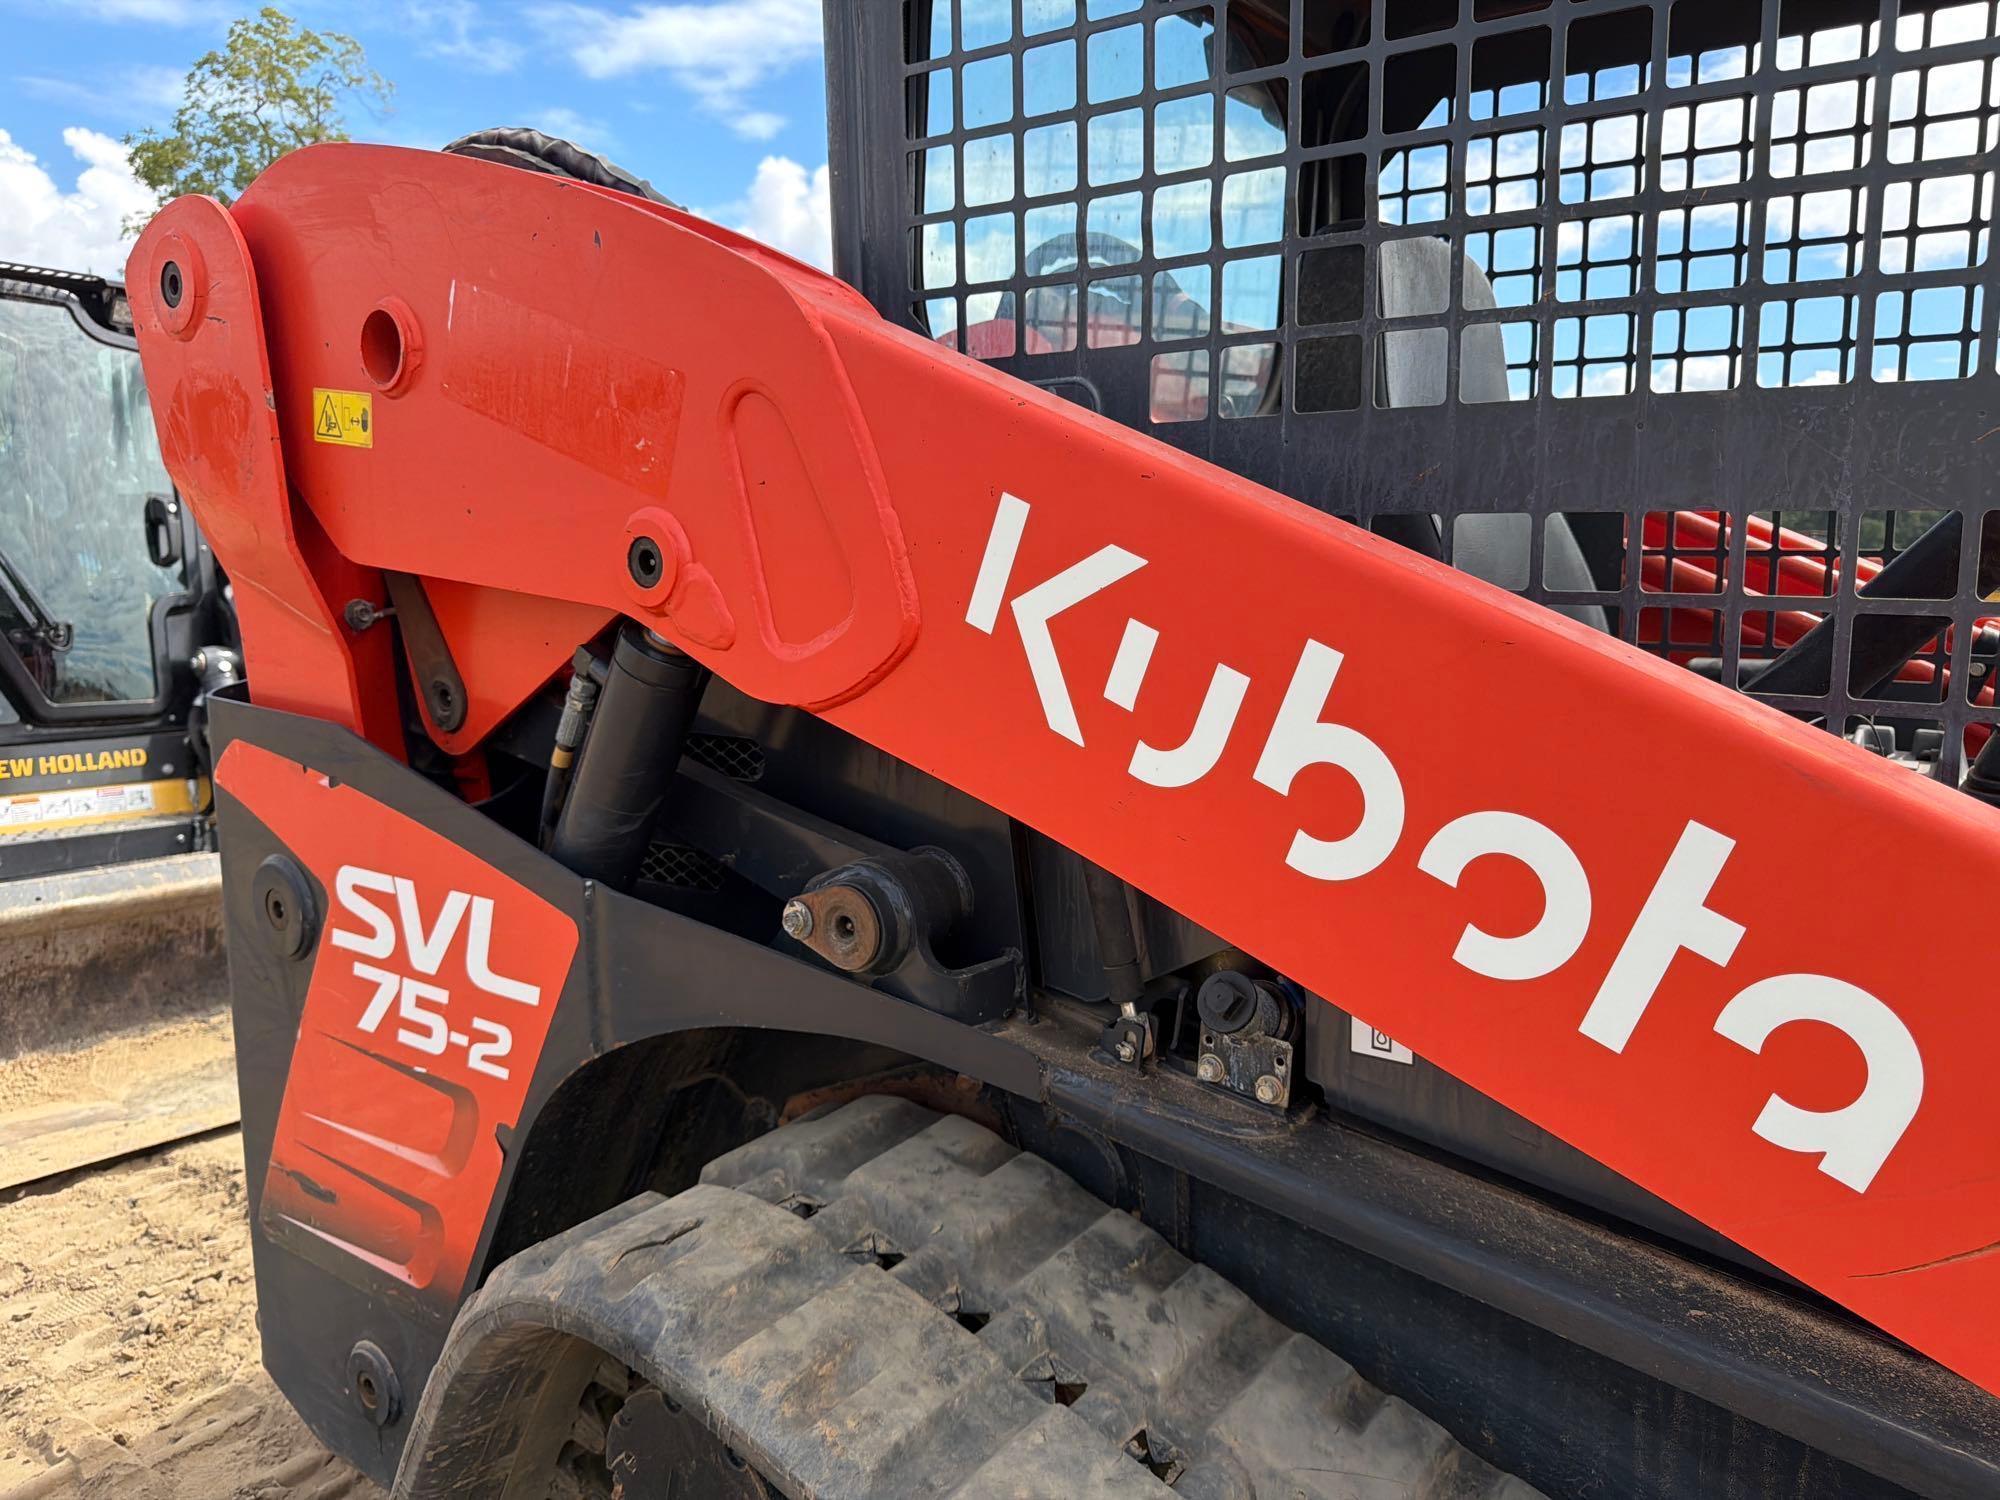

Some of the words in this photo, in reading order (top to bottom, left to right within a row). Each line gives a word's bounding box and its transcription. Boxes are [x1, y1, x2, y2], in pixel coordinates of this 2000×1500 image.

[39, 748, 147, 775] HOLLAND
[966, 492, 1924, 1194] Kubota
[331, 864, 541, 1006] SVL
[353, 961, 513, 1080] 75-2
